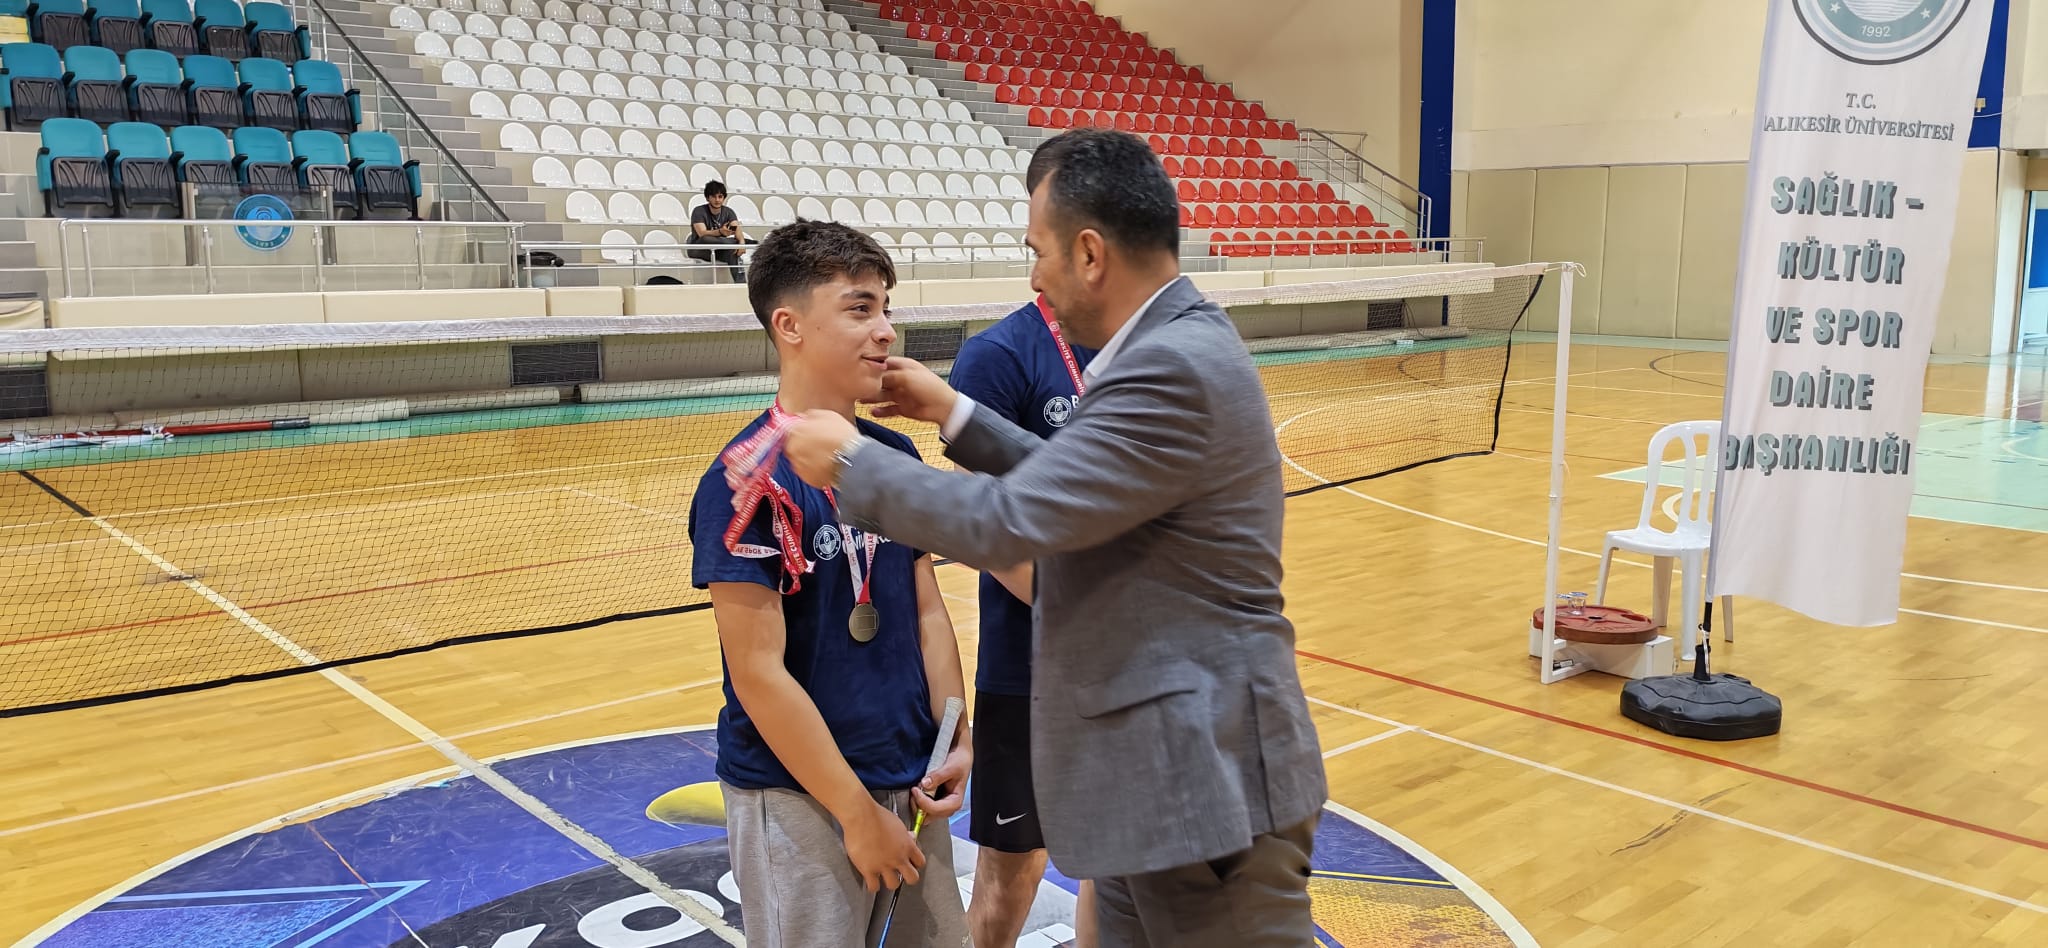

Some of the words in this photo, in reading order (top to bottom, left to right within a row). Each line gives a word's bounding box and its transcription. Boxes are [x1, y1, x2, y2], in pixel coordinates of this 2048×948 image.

[1861, 24, 1892, 38] 1992
[1846, 92, 1877, 109] T.C.
[1763, 114, 1841, 134] ALIKESİR
[1844, 118, 1955, 141] ÜNİVERSİTESİ
[1770, 170, 1898, 219] SAĞLIK
[1777, 235, 1905, 285] KÜLTÜR
[1766, 306, 1803, 344] VE
[1812, 307, 1903, 349] SPOR
[1067, 360, 1086, 394] CUMHURİY
[1769, 365, 1875, 411] DAİRE
[1724, 431, 1911, 476] BAŞKANLIĞI
